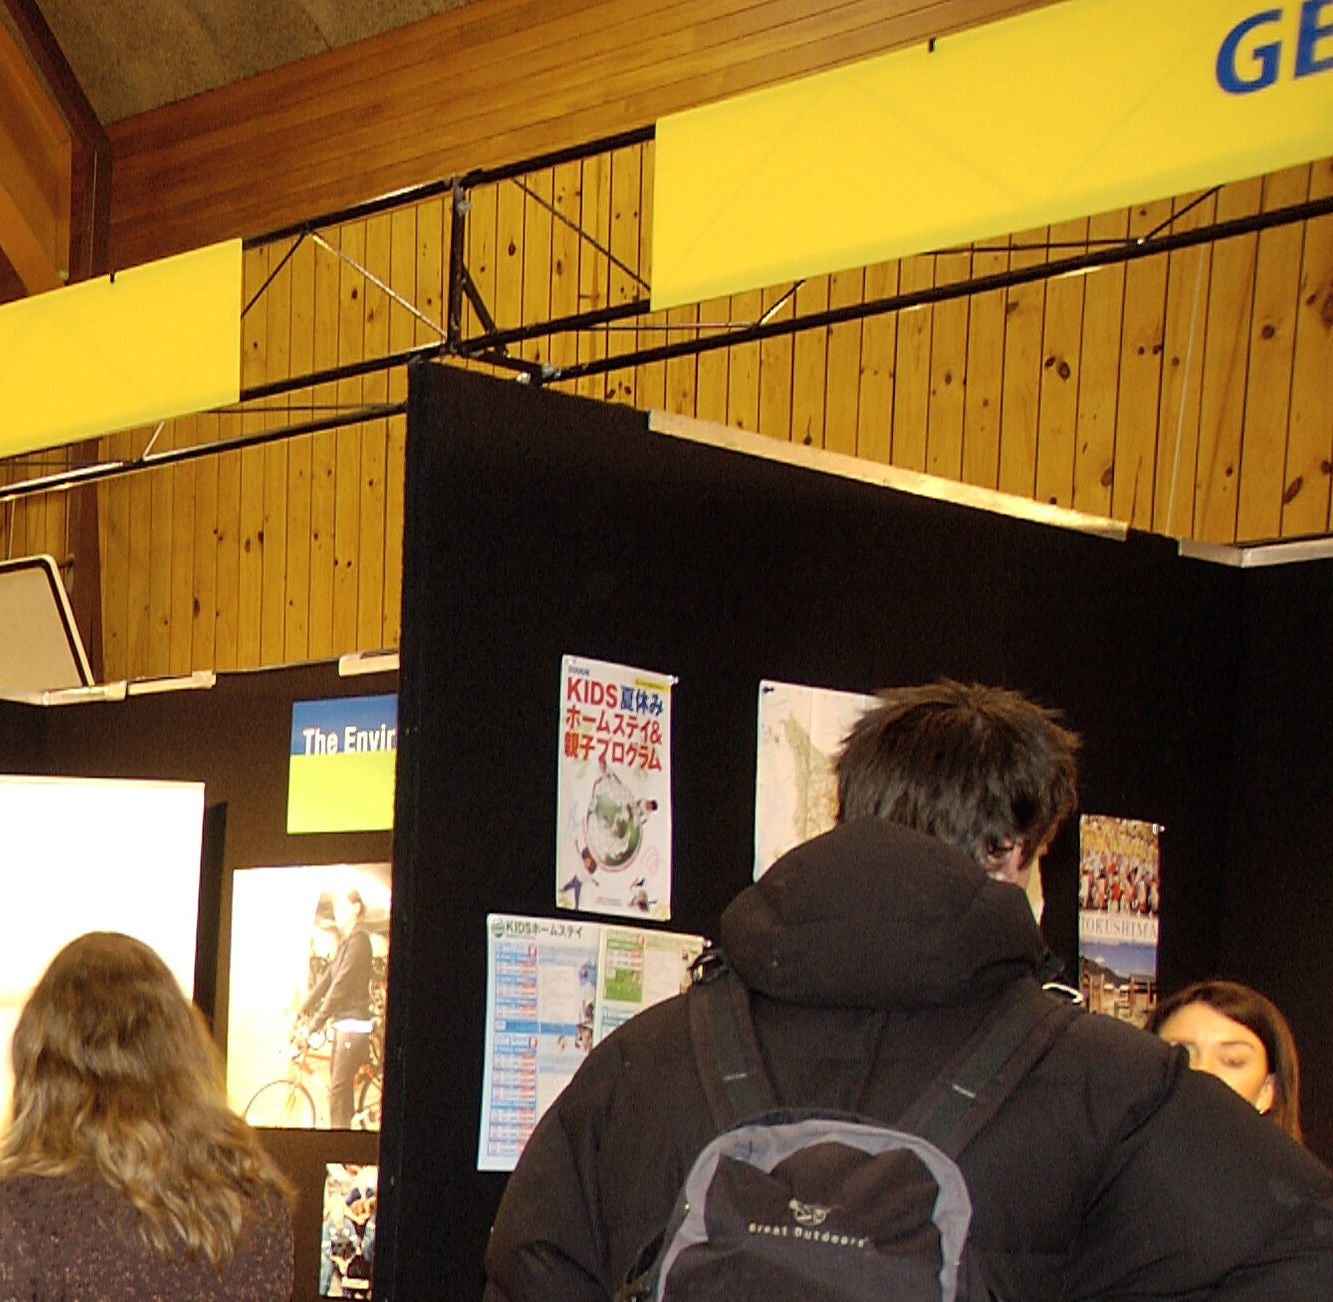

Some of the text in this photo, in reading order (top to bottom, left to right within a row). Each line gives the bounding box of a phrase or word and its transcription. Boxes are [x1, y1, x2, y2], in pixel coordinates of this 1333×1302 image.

[566, 675, 618, 710] KIDS
[302, 721, 396, 755] The Envir
